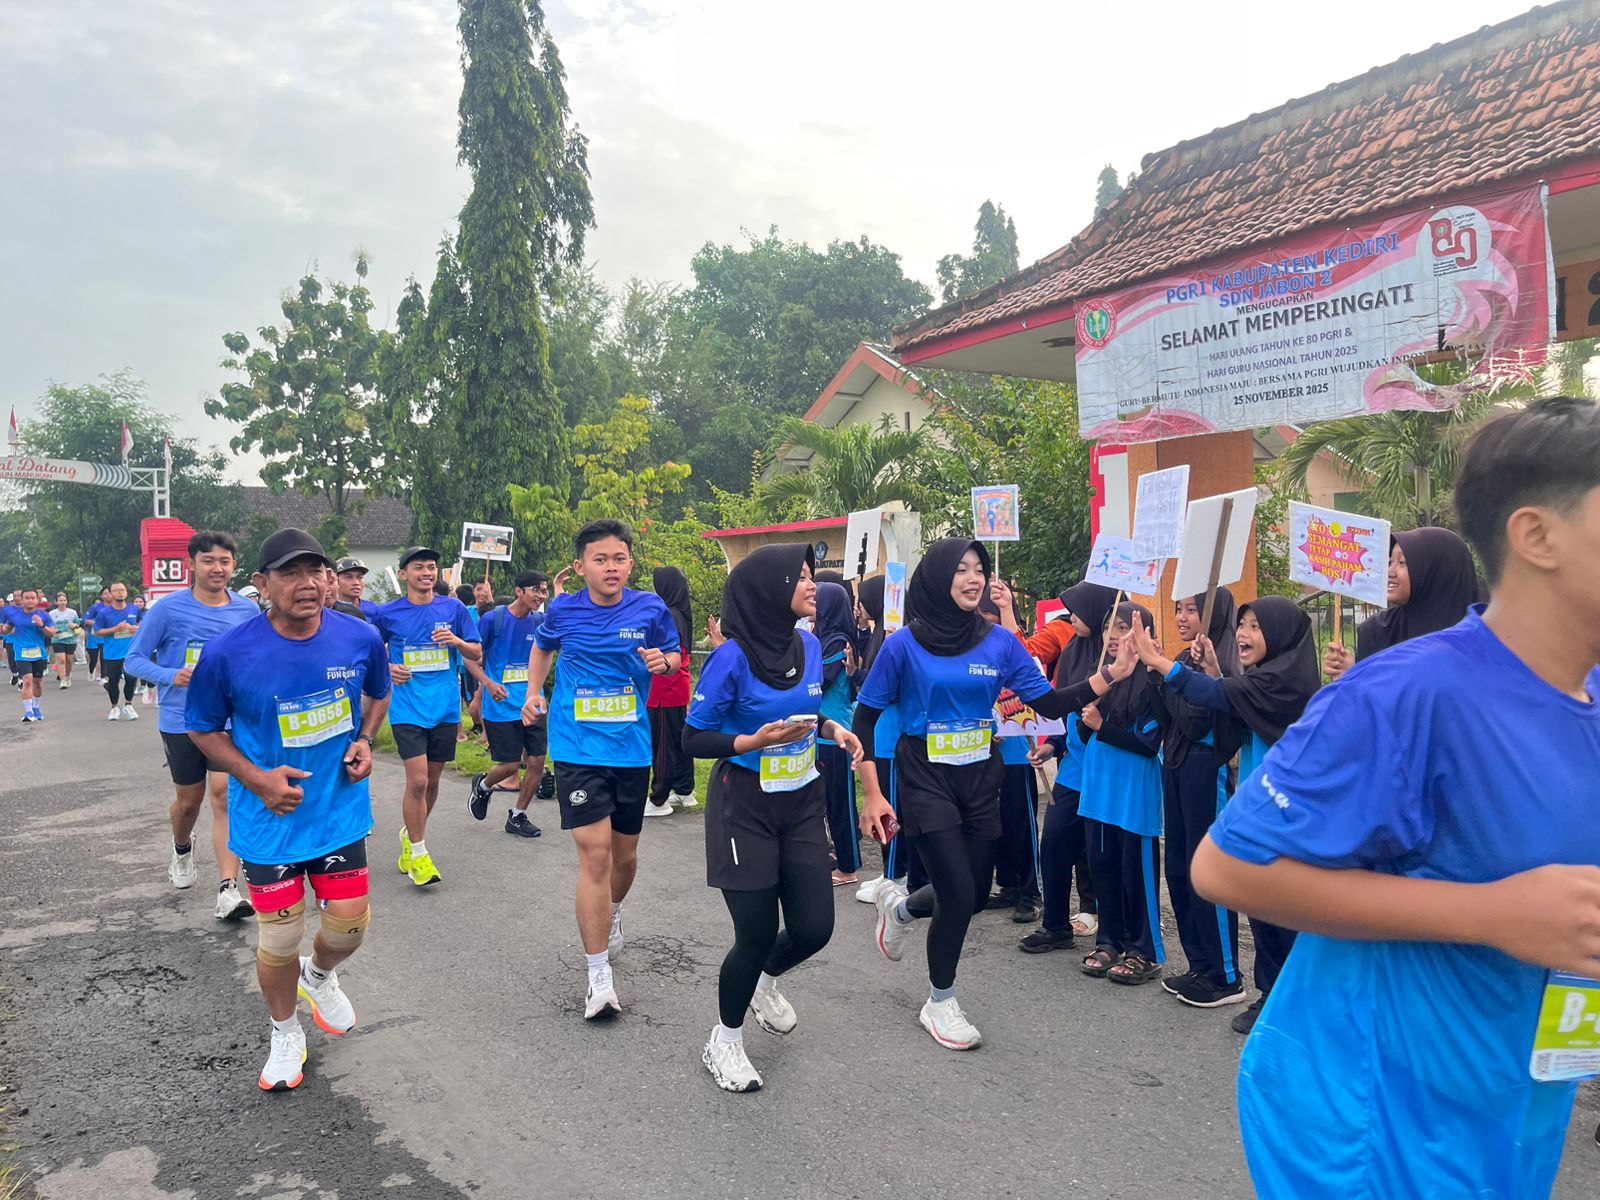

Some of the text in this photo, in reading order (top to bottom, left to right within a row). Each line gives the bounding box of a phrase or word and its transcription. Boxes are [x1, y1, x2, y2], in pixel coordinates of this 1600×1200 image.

[1166, 231, 1400, 304] PGRI KABUPATEN KEDIRI
[1218, 269, 1333, 308] SDN JABON 2
[1236, 291, 1314, 316] MENGUCAPKAN
[1160, 319, 1241, 351] SELAMAT
[1245, 283, 1415, 334] MEMPERINGATI
[1209, 327, 1354, 362] HARI ULANG TAHUN KE 80 PGRI &
[1206, 344, 1358, 379] HARI GURU NASIONAL TAHUN 2025
[1183, 383, 1229, 399] INDONESIA
[1258, 372, 1303, 388] BERSAMA
[1304, 366, 1329, 379] PGRI
[1331, 355, 1390, 374] WUJUDKAN
[1233, 382, 1329, 405] 25 NOVEMBER 2025
[17, 457, 78, 480] Datang
[1308, 534, 1361, 553] SEMANGAT
[1309, 544, 1331, 556] TETAP
[1309, 553, 1362, 573] KASIH PAHAM
[619, 631, 632, 639] FUN
[326, 671, 342, 680] FUN
[968, 667, 983, 676] FUN
[288, 702, 344, 731] B-0658
[582, 697, 630, 713] B-0215
[935, 731, 984, 750] B-0529
[1557, 991, 1600, 1034] B-
